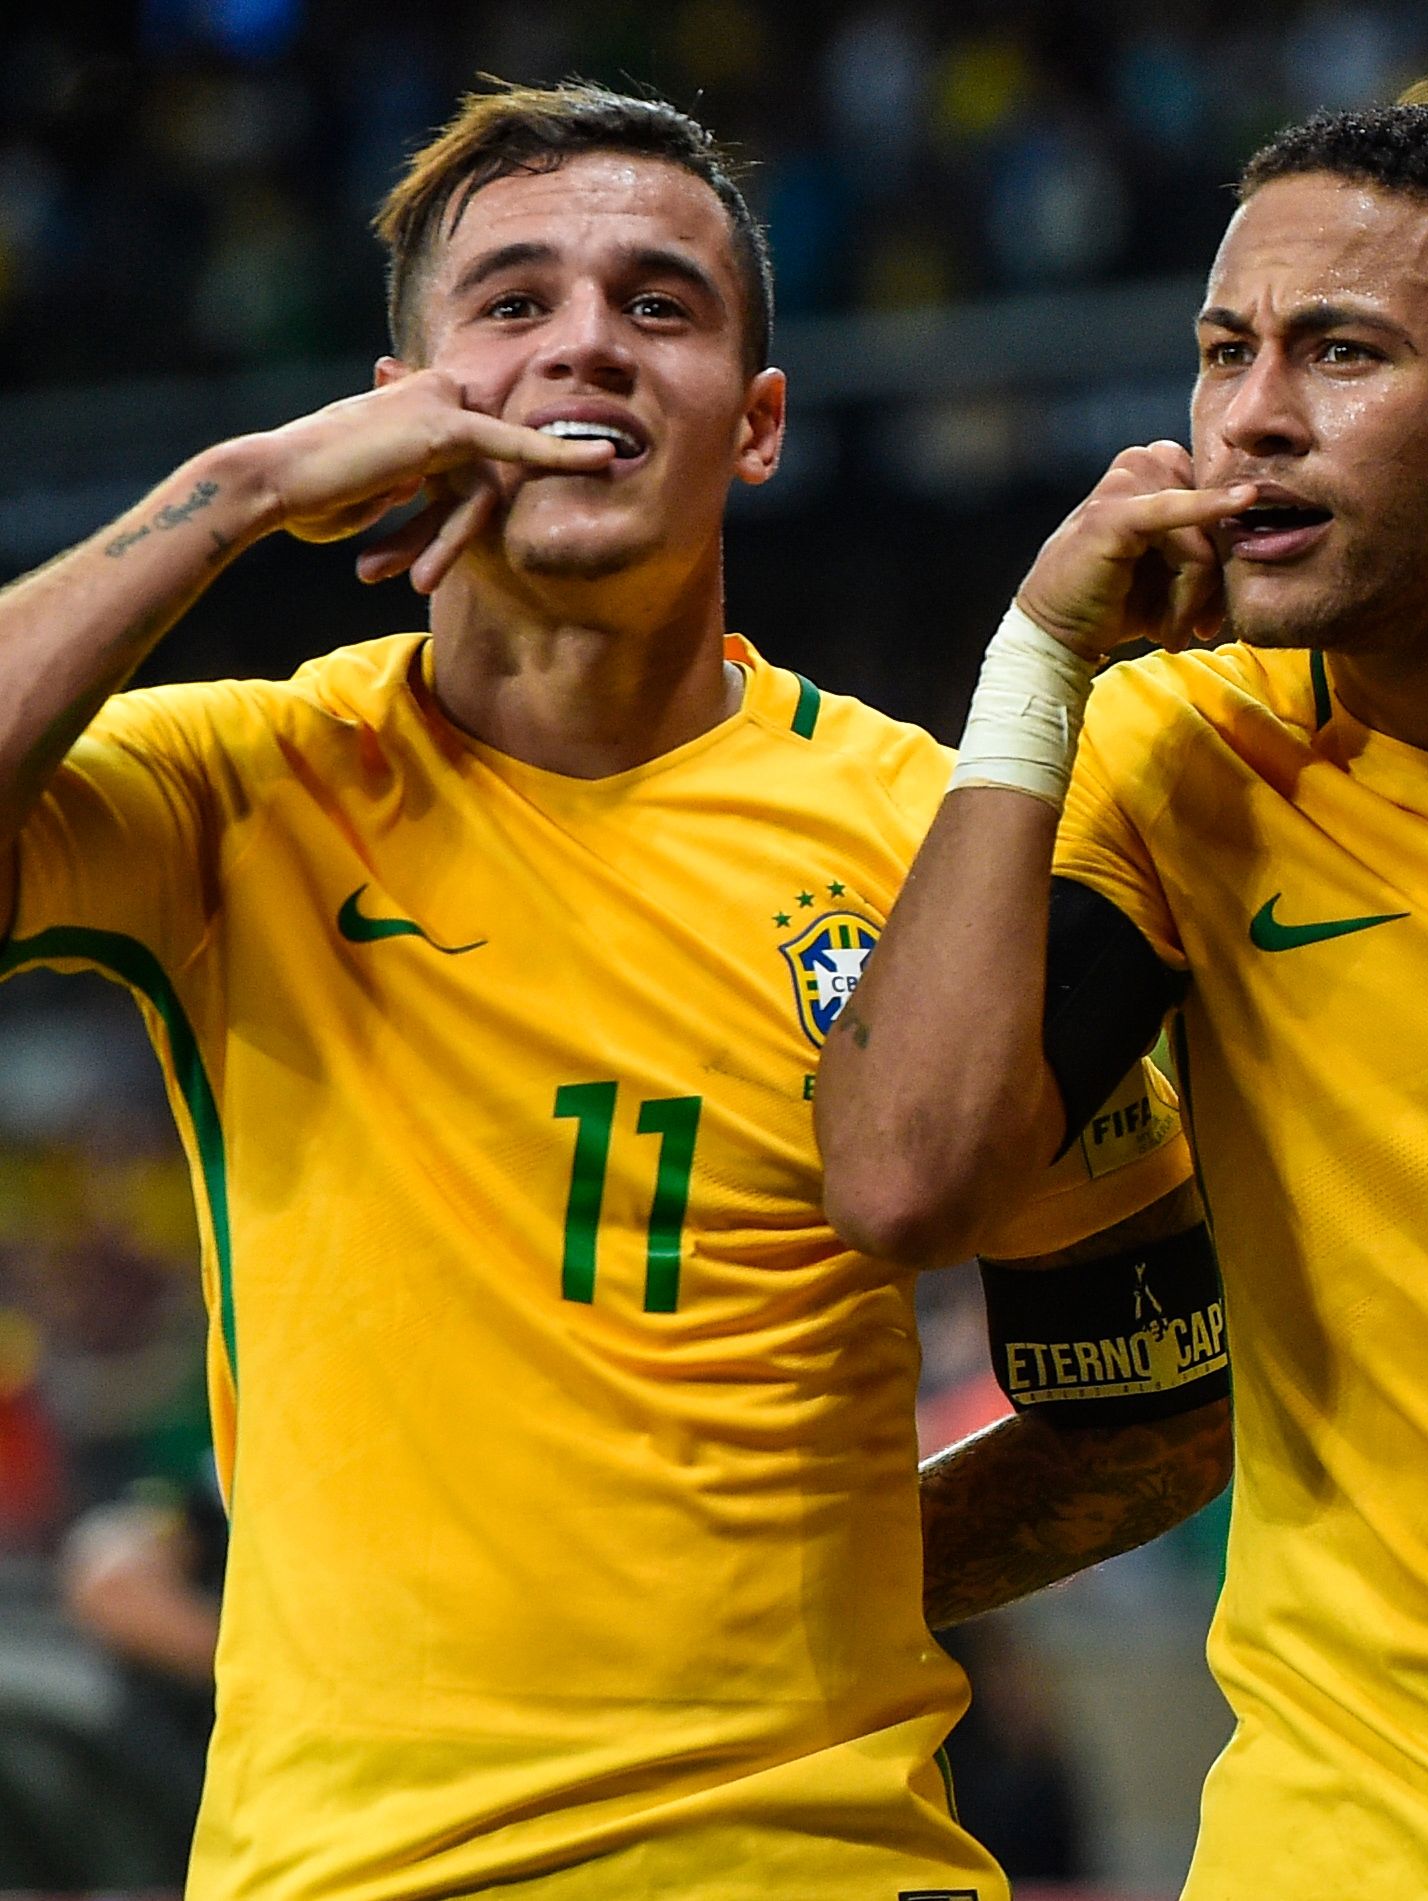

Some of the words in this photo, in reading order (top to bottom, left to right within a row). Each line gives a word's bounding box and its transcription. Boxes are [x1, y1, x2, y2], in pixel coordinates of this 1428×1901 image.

[831, 975, 858, 993] CB
[553, 1080, 702, 1313] 11
[1005, 1331, 1152, 1390] ETERNO
[1168, 1299, 1224, 1368] CAP
